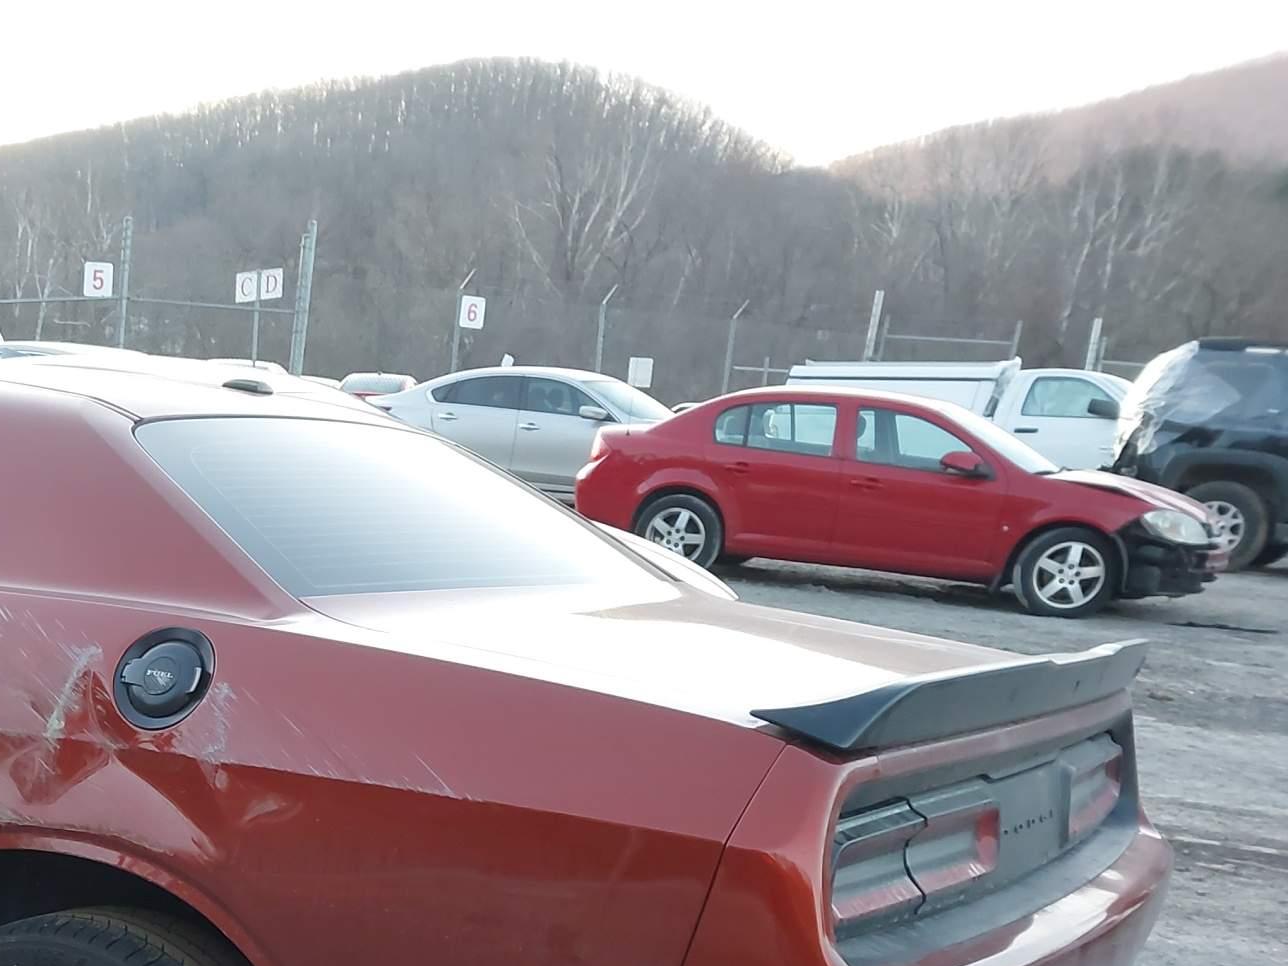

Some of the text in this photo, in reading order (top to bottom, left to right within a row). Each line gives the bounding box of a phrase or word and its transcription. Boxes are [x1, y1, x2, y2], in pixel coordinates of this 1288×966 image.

[92, 269, 105, 290] 5
[241, 276, 253, 297] C
[266, 275, 278, 293] D
[467, 303, 478, 322] 6
[146, 668, 173, 679] FUEL
